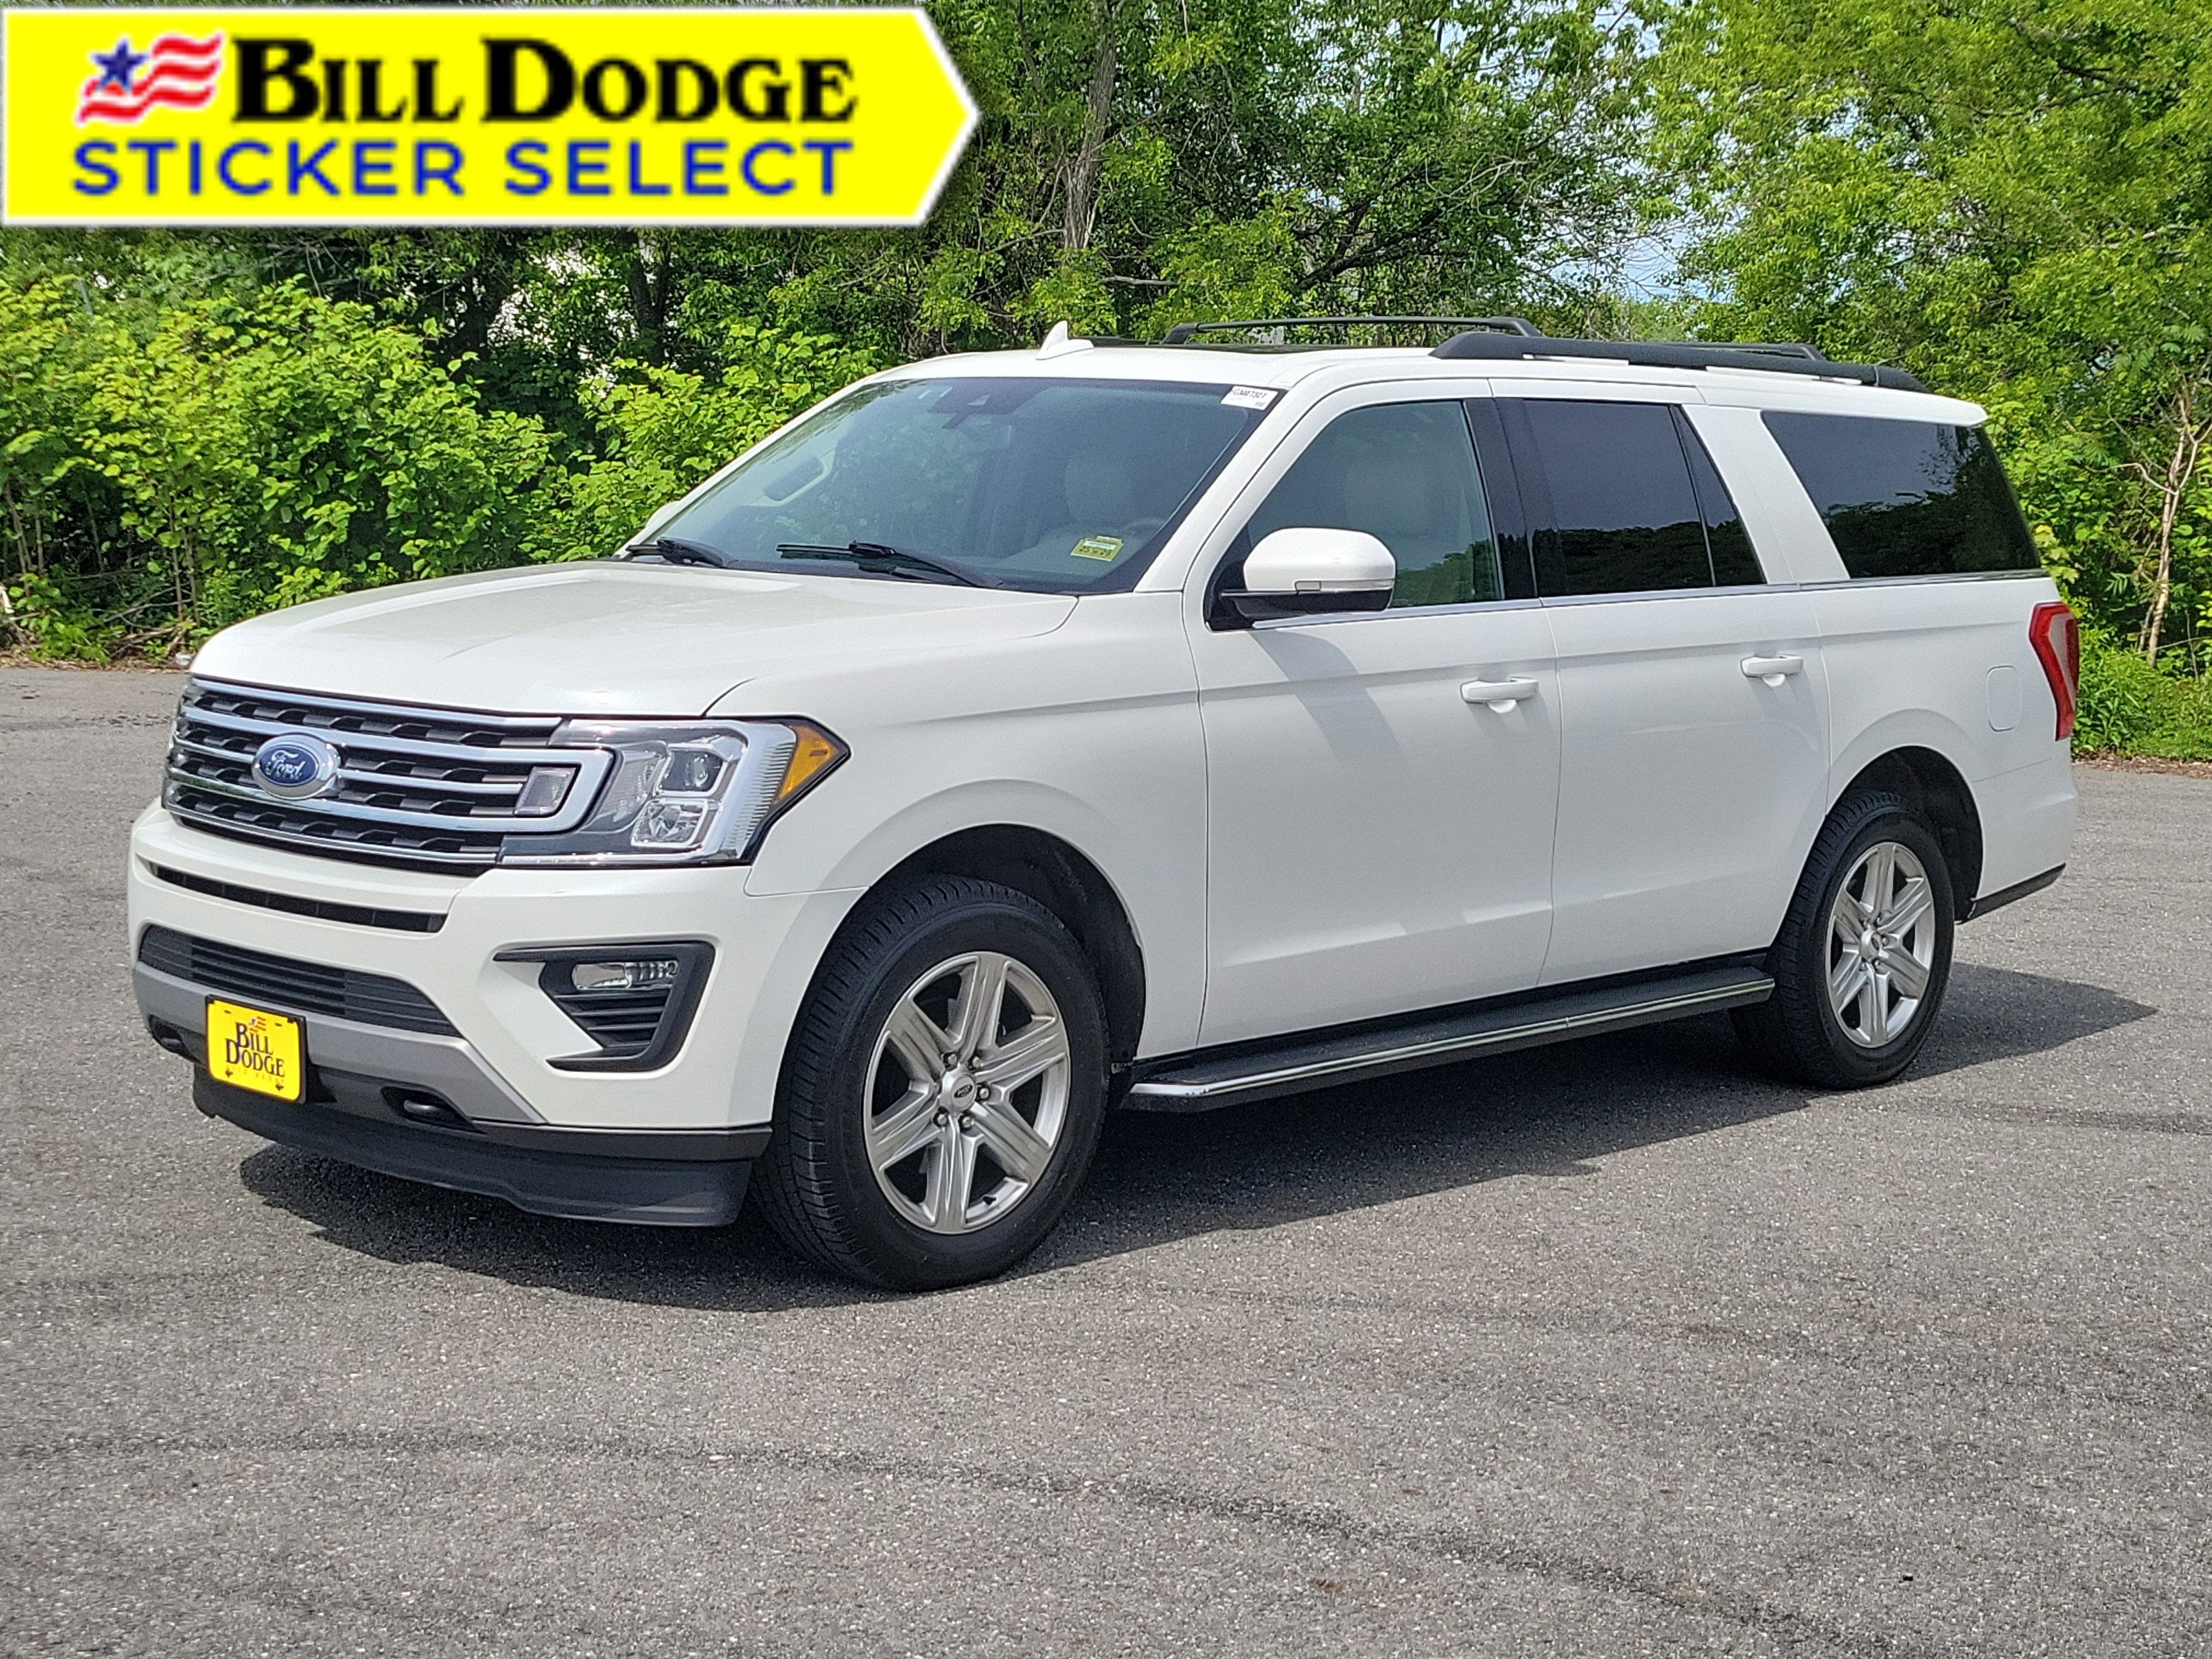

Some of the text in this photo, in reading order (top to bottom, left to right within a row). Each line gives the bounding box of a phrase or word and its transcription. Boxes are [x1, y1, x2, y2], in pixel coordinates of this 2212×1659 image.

[266, 749, 307, 777] Ford
[235, 1022, 273, 1056] BILL
[225, 1038, 285, 1077] DODGE
